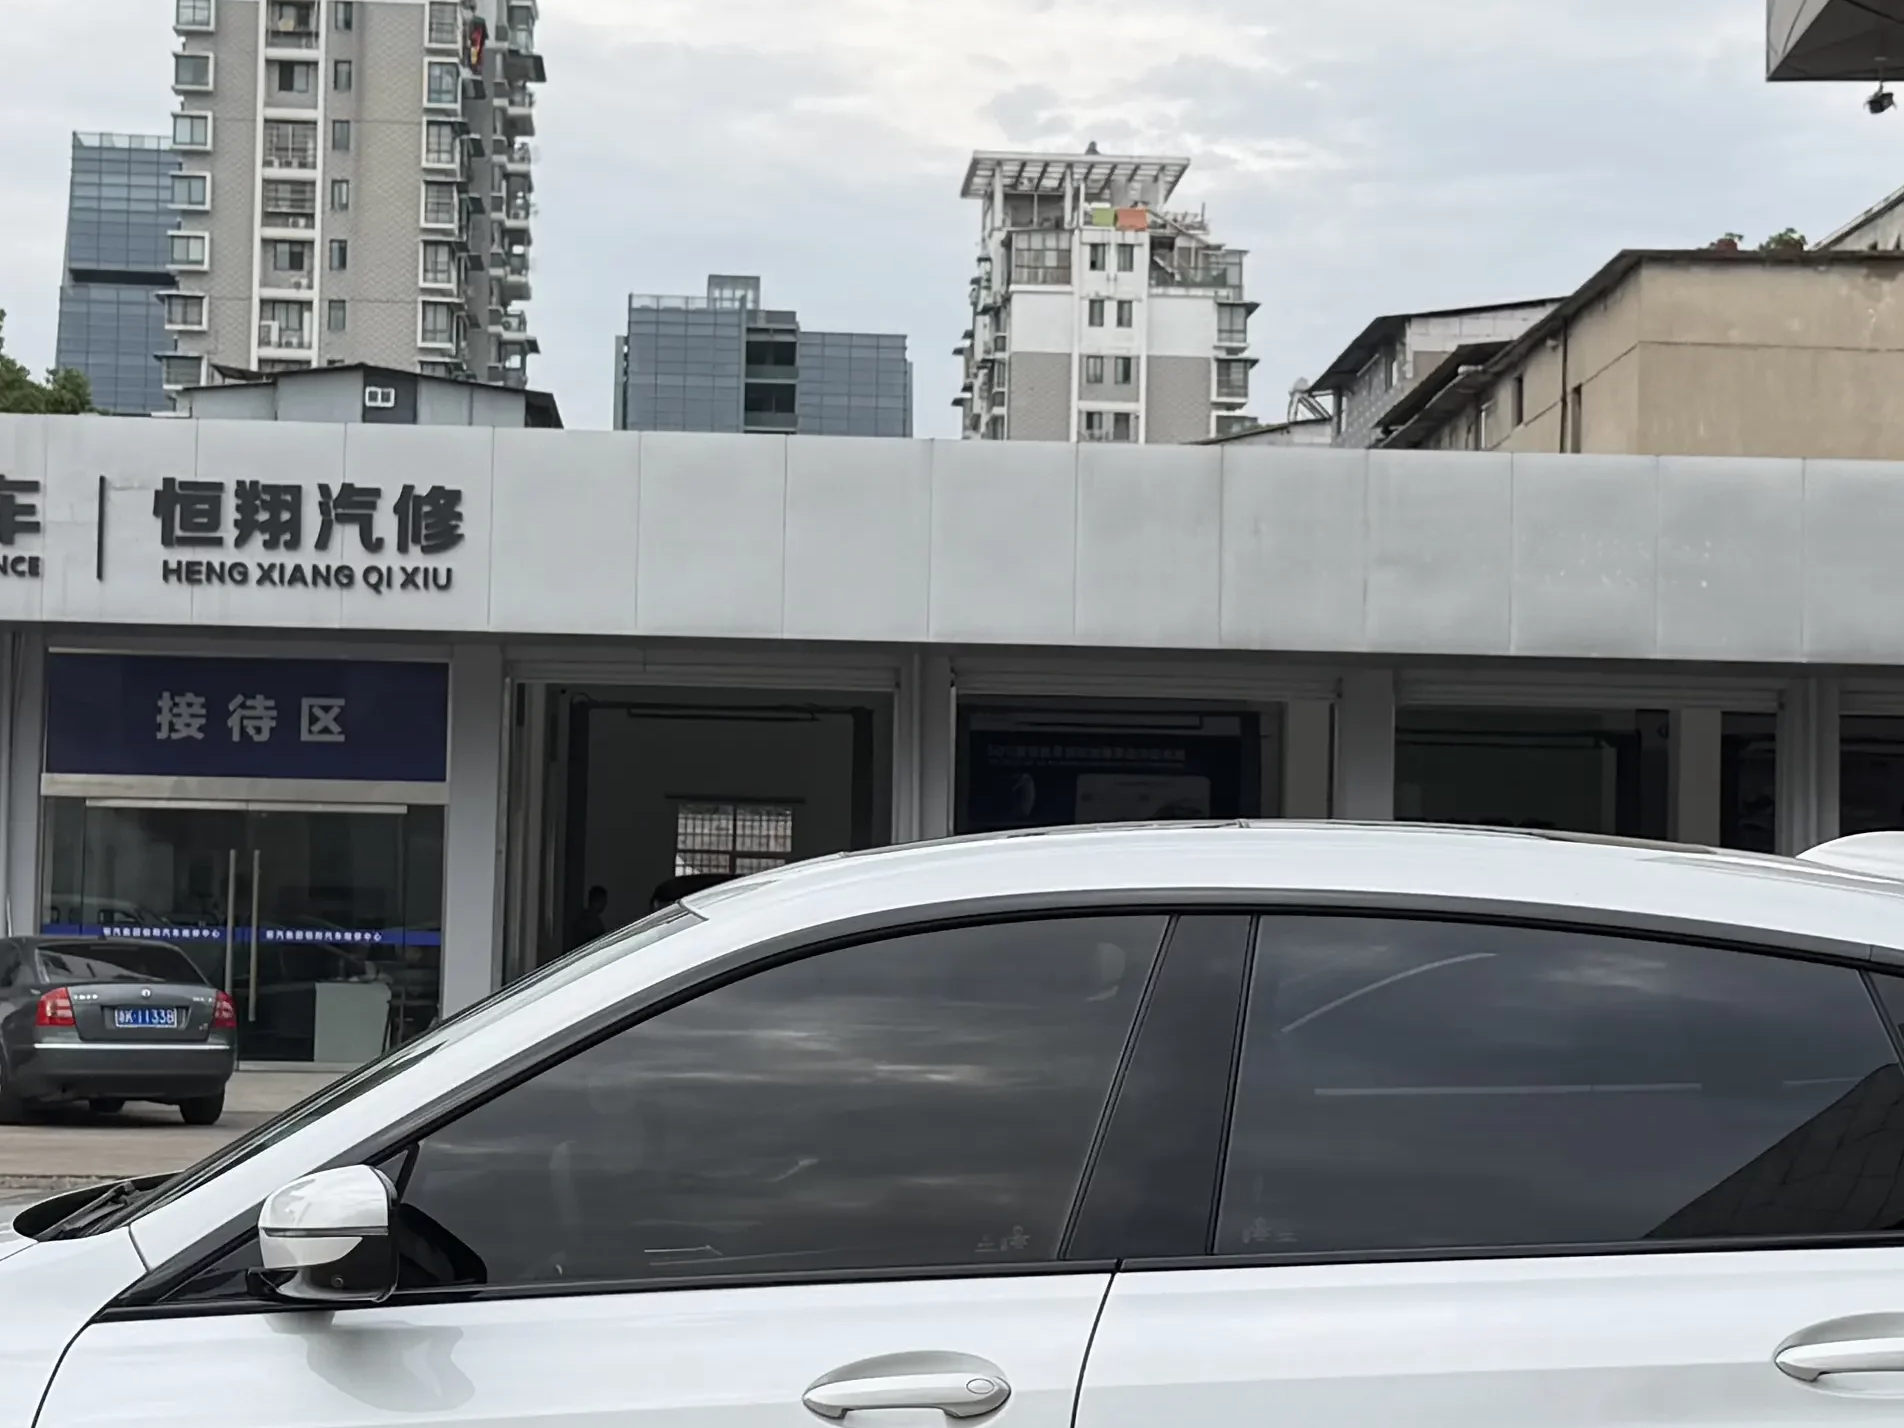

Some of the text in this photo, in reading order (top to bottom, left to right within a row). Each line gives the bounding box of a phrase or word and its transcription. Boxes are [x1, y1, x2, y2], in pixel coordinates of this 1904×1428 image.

[152, 476, 465, 554] 恒翔汽修
[162, 560, 454, 594] HENG XIANG QI XIU
[156, 691, 346, 742] 接待区
